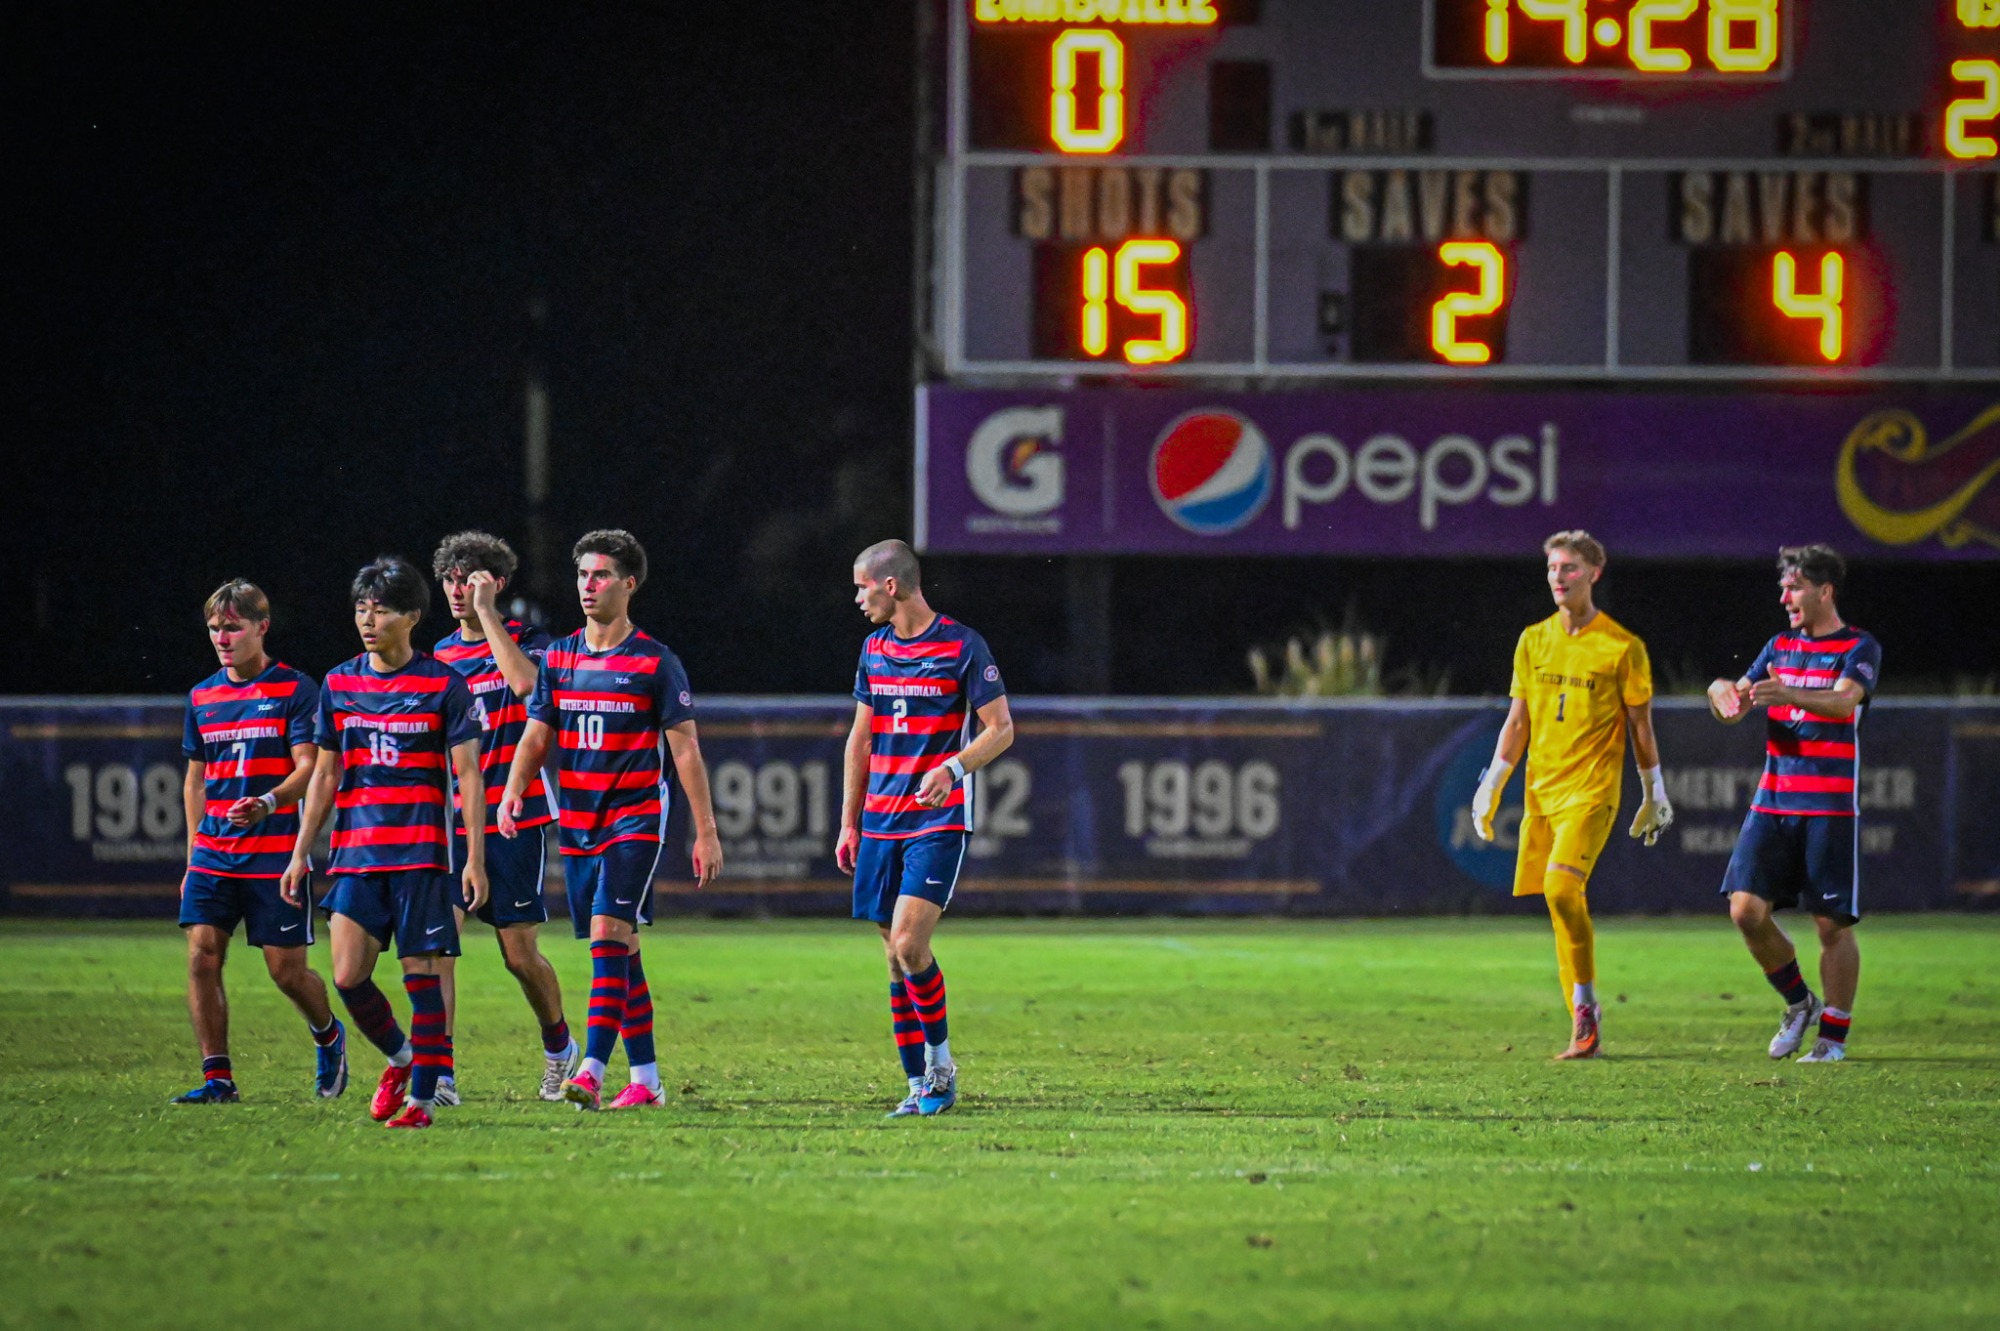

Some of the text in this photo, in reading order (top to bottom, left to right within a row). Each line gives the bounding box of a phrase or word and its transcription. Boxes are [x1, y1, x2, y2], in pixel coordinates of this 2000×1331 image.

[1051, 28, 1124, 154] 0
[1019, 168, 1202, 240] SHOTS
[1341, 169, 1518, 242] SAVES
[1680, 171, 1858, 244] SAVES
[1081, 239, 1187, 364] 15
[1431, 241, 1504, 363] 2
[1772, 250, 1844, 361] 4
[1283, 422, 1559, 531] pepsi
[243, 726, 278, 739] INDIANA
[388, 721, 429, 734] INDIANA
[577, 713, 604, 750] 10
[597, 700, 635, 713] INDIANA
[893, 698, 908, 734] 2
[231, 742, 246, 777] 7
[369, 731, 400, 767] 16
[65, 764, 184, 841] 198
[1119, 761, 1280, 839] 1996
